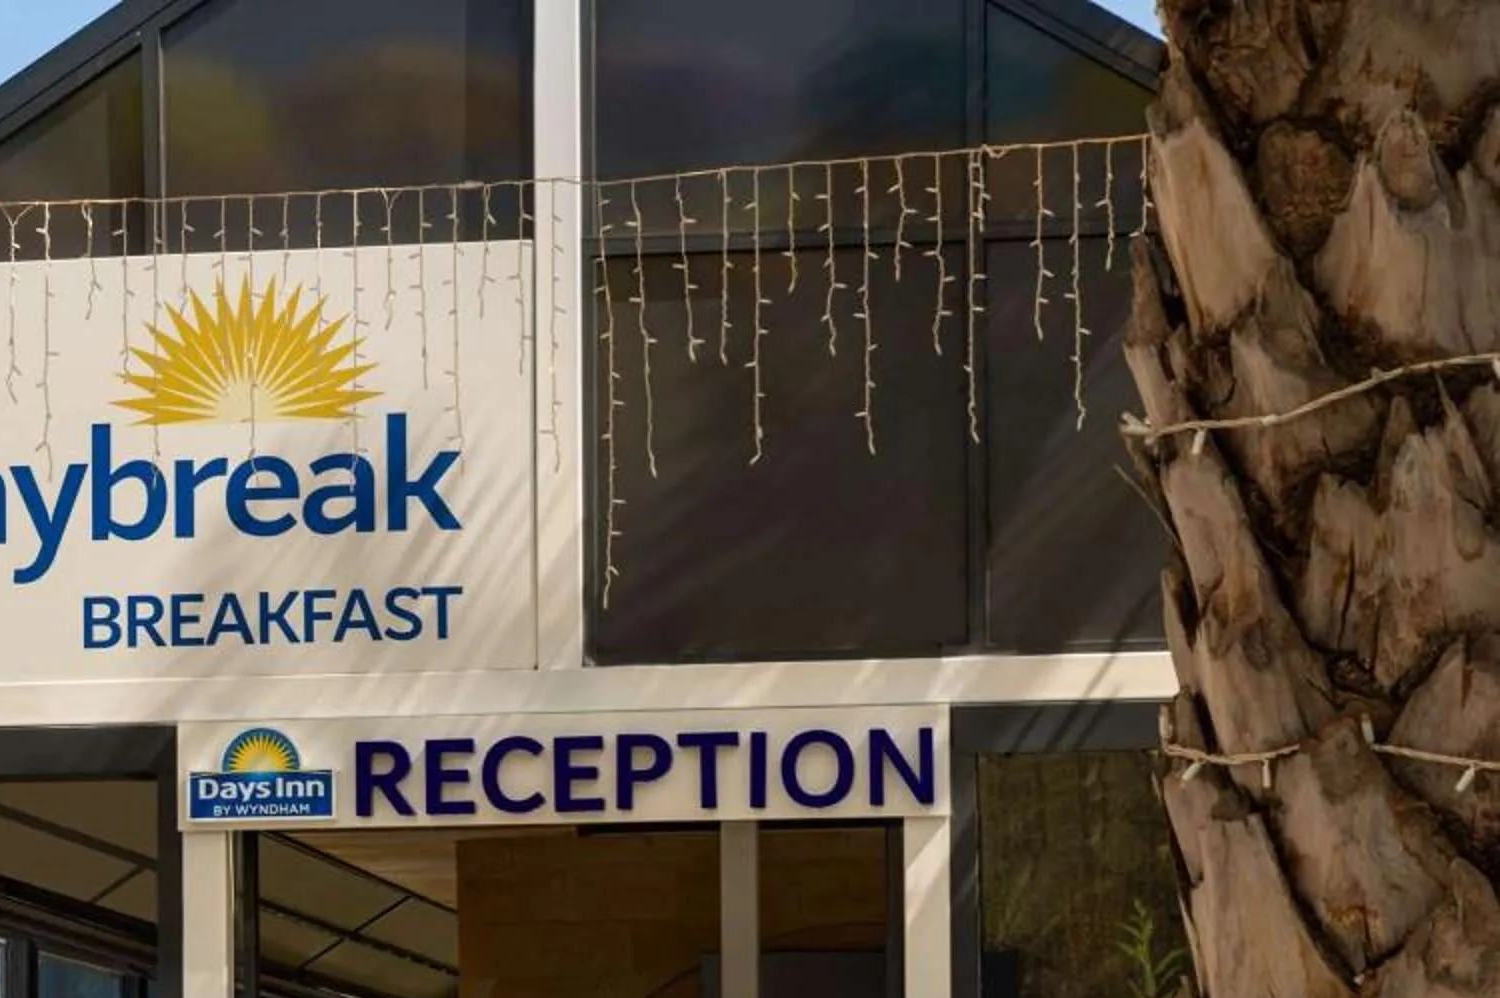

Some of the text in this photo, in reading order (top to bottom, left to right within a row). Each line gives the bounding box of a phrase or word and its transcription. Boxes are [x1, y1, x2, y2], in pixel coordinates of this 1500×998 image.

[83, 586, 463, 651] BREAKFAST
[198, 776, 325, 801] Days Inn
[354, 727, 936, 818] RECEPTION
[213, 803, 311, 816] BY WYNDHAM
